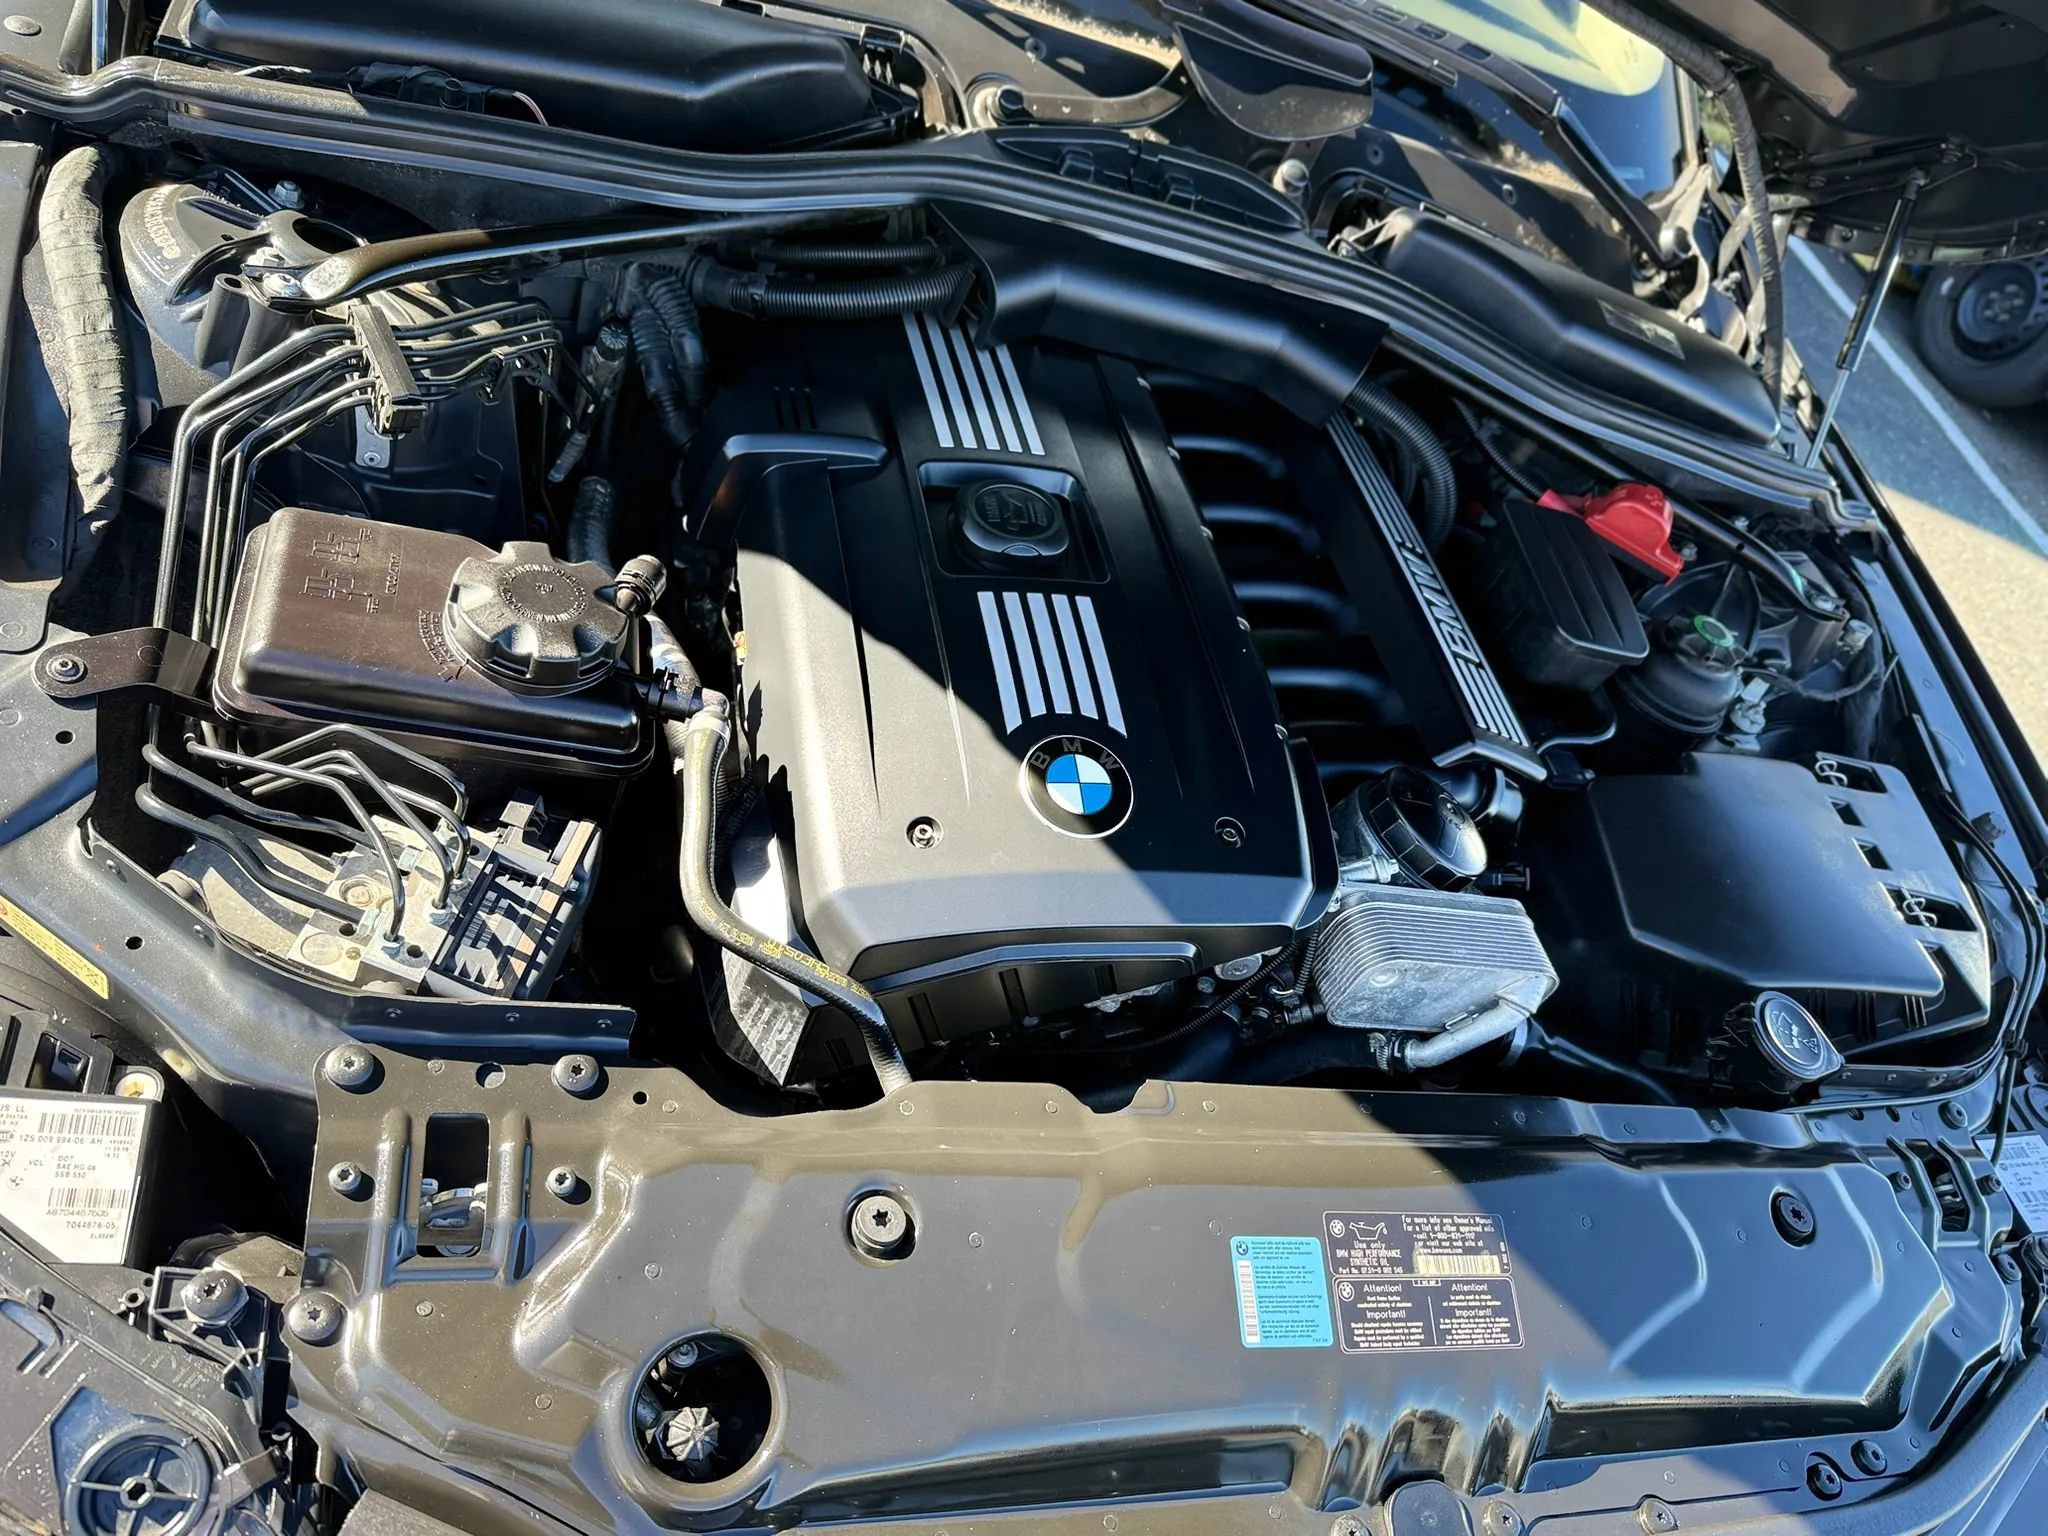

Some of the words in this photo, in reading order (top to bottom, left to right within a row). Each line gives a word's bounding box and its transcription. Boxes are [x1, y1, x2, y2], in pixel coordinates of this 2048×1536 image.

[1398, 548, 1481, 664] BMW
[1030, 738, 1120, 770] BMW
[1353, 1240, 1367, 1249] Use
[1370, 1240, 1386, 1250] only
[1336, 1248, 1349, 1258] BMW
[1363, 1283, 1402, 1293] Attention!
[1451, 1283, 1488, 1292] Attention!
[1366, 1309, 1406, 1320] Important!
[1455, 1308, 1492, 1318] Important!
